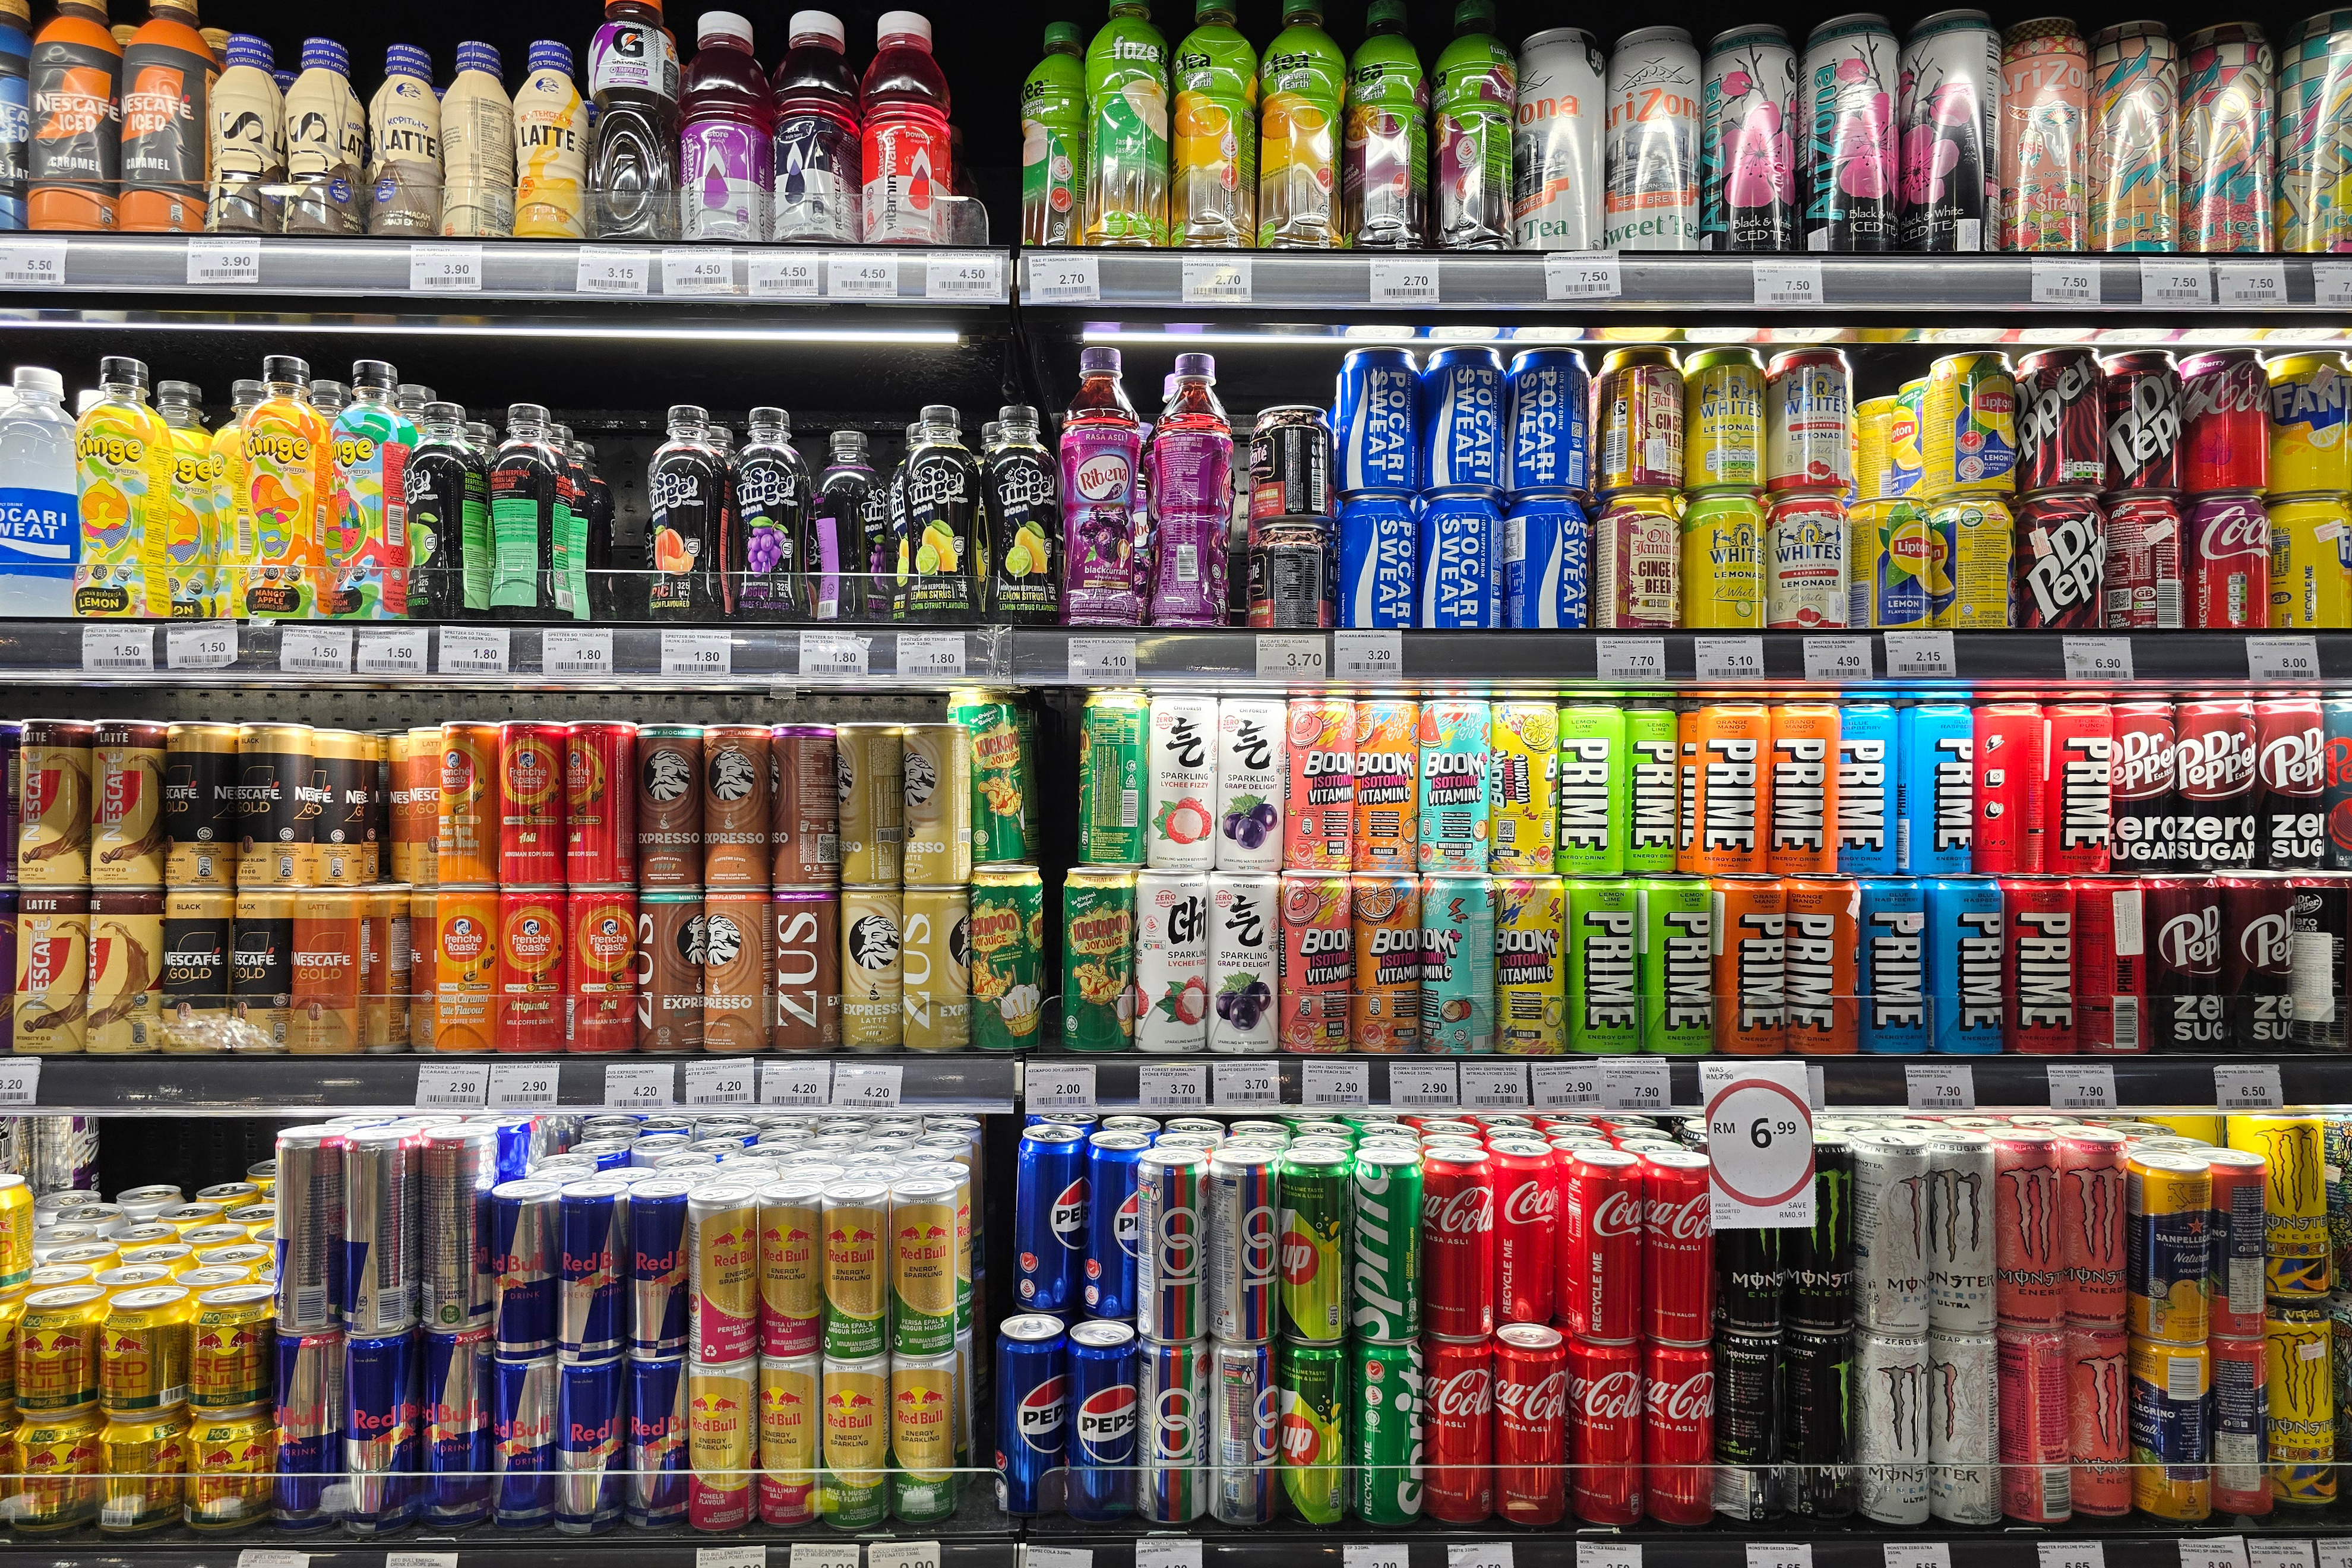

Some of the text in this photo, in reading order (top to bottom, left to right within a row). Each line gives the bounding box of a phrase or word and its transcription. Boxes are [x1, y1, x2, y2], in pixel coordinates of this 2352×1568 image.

[1092, 94, 1099, 115] ME
[132, 114, 166, 132] ICED
[388, 116, 428, 131] KOPITIAM
[521, 124, 576, 151] LATTE
[127, 158, 170, 171] CARAMEL
[1617, 197, 1642, 208] REAL
[1524, 218, 1568, 239] Tea
[1733, 216, 1762, 229] Black
[1763, 217, 1771, 227] &
[1734, 232, 1766, 243] ICED
[28, 260, 51, 271] 5.50
[222, 256, 251, 267] 3.90
[608, 268, 633, 279] 3.15
[695, 265, 720, 274] 4.50
[1060, 273, 1085, 285] 2.70
[1580, 271, 1607, 282] 7.50
[1785, 280, 1809, 290] 7.50
[2196, 359, 2225, 369] Cherry
[1368, 371, 1389, 471] SWEAT
[1387, 372, 1406, 482] POCARI
[75, 430, 143, 465] tinge
[1080, 466, 1130, 490] Ribena
[737, 479, 794, 503] Tinge!
[741, 505, 763, 517] SODA
[1775, 543, 1841, 561] WHITES
[1898, 540, 1930, 554] Lipton
[1084, 567, 1128, 576] blackcurrant
[1639, 560, 1676, 578] GINGER
[2305, 565, 2313, 580] ME
[1645, 578, 1671, 593] BEER
[929, 590, 952, 600] SITRUS
[113, 646, 140, 657] 1.50
[473, 649, 497, 660] 1.80
[1915, 651, 1940, 662] 2.15
[1101, 656, 1126, 666] 4.10
[1286, 653, 1322, 666] 3.70
[1629, 656, 1654, 666] 7.70
[1727, 656, 1753, 666] 5.10
[2095, 658, 2120, 669] 6.90
[2283, 658, 2306, 668] 8.00
[2203, 731, 2245, 760] Dr
[1161, 772, 1208, 780] SPARKLING
[1432, 776, 1478, 789] ISOTONIC
[1428, 788, 1474, 805] VITAMIN
[1563, 739, 1608, 849] PRIME
[2177, 815, 2255, 840] zero
[519, 833, 536, 843] Asli
[2177, 841, 2255, 860] SUGAR
[27, 899, 56, 910] LATTE
[1073, 915, 1130, 942] KICKAPOO
[512, 935, 550, 945] Frenché
[516, 943, 546, 951] Roast
[170, 967, 211, 980] GOLD
[777, 912, 817, 1028] ZUS
[511, 1000, 549, 1011] Originale
[450, 1083, 475, 1093] 2.90
[633, 1086, 657, 1096] 4.20
[1056, 1084, 1080, 1094] 2.00
[1335, 1083, 1357, 1093] 2.90
[1634, 1086, 1659, 1097] 7.90
[1936, 1086, 1961, 1096] 7.90
[2242, 1086, 2265, 1096] 6.50
[1714, 1123, 1735, 1133] RM
[1159, 1207, 1199, 1291] 100
[764, 1248, 809, 1263] Red Bull
[1282, 1243, 1312, 1275] up
[1592, 1252, 1602, 1332] RECYCLE ME
[1937, 1299, 1970, 1308] ULTRA
[220, 1310, 259, 1322] ENERGY
[194, 1354, 263, 1372] RED
[194, 1372, 263, 1386] BULL
[1082, 1414, 1135, 1432] PEPS
[1649, 1418, 1671, 1430] RASA
